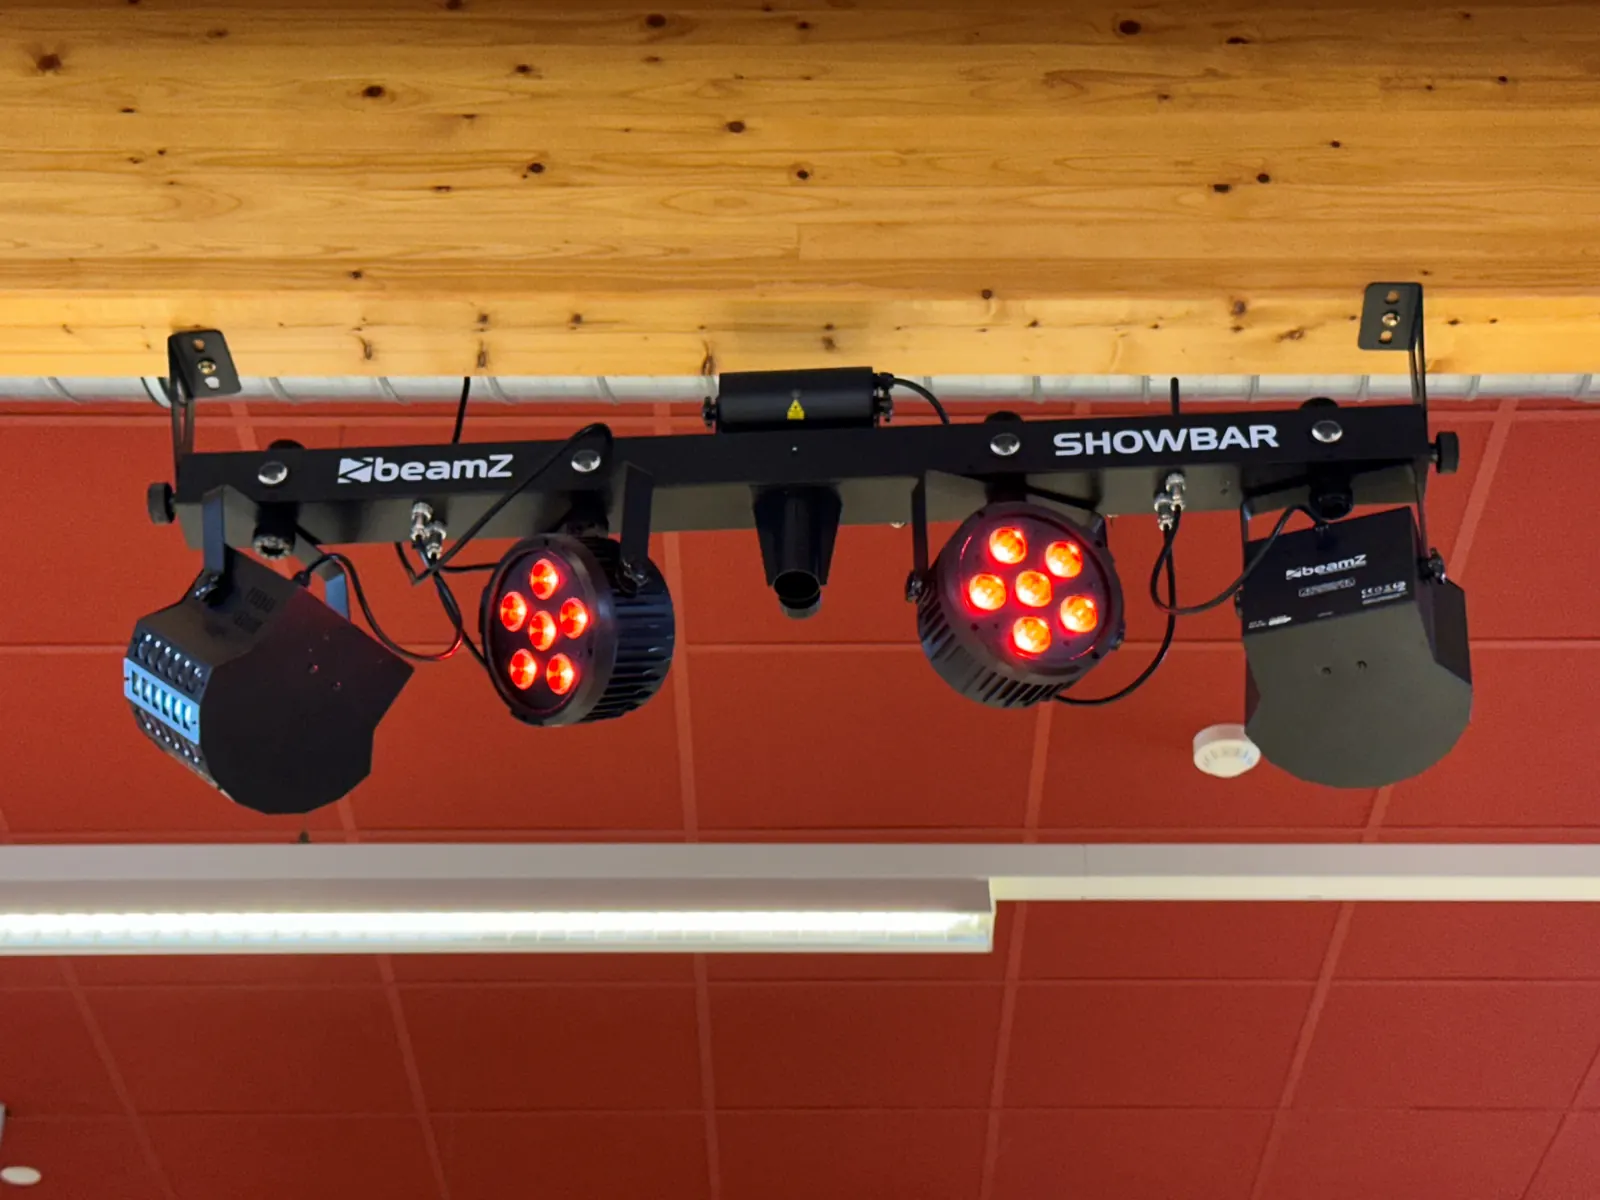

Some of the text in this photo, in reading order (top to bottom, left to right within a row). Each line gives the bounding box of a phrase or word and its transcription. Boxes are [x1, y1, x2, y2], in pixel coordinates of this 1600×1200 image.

[1053, 424, 1279, 456] SHOWBAR
[374, 454, 513, 482] beamZ
[1302, 554, 1367, 576] beamZ
